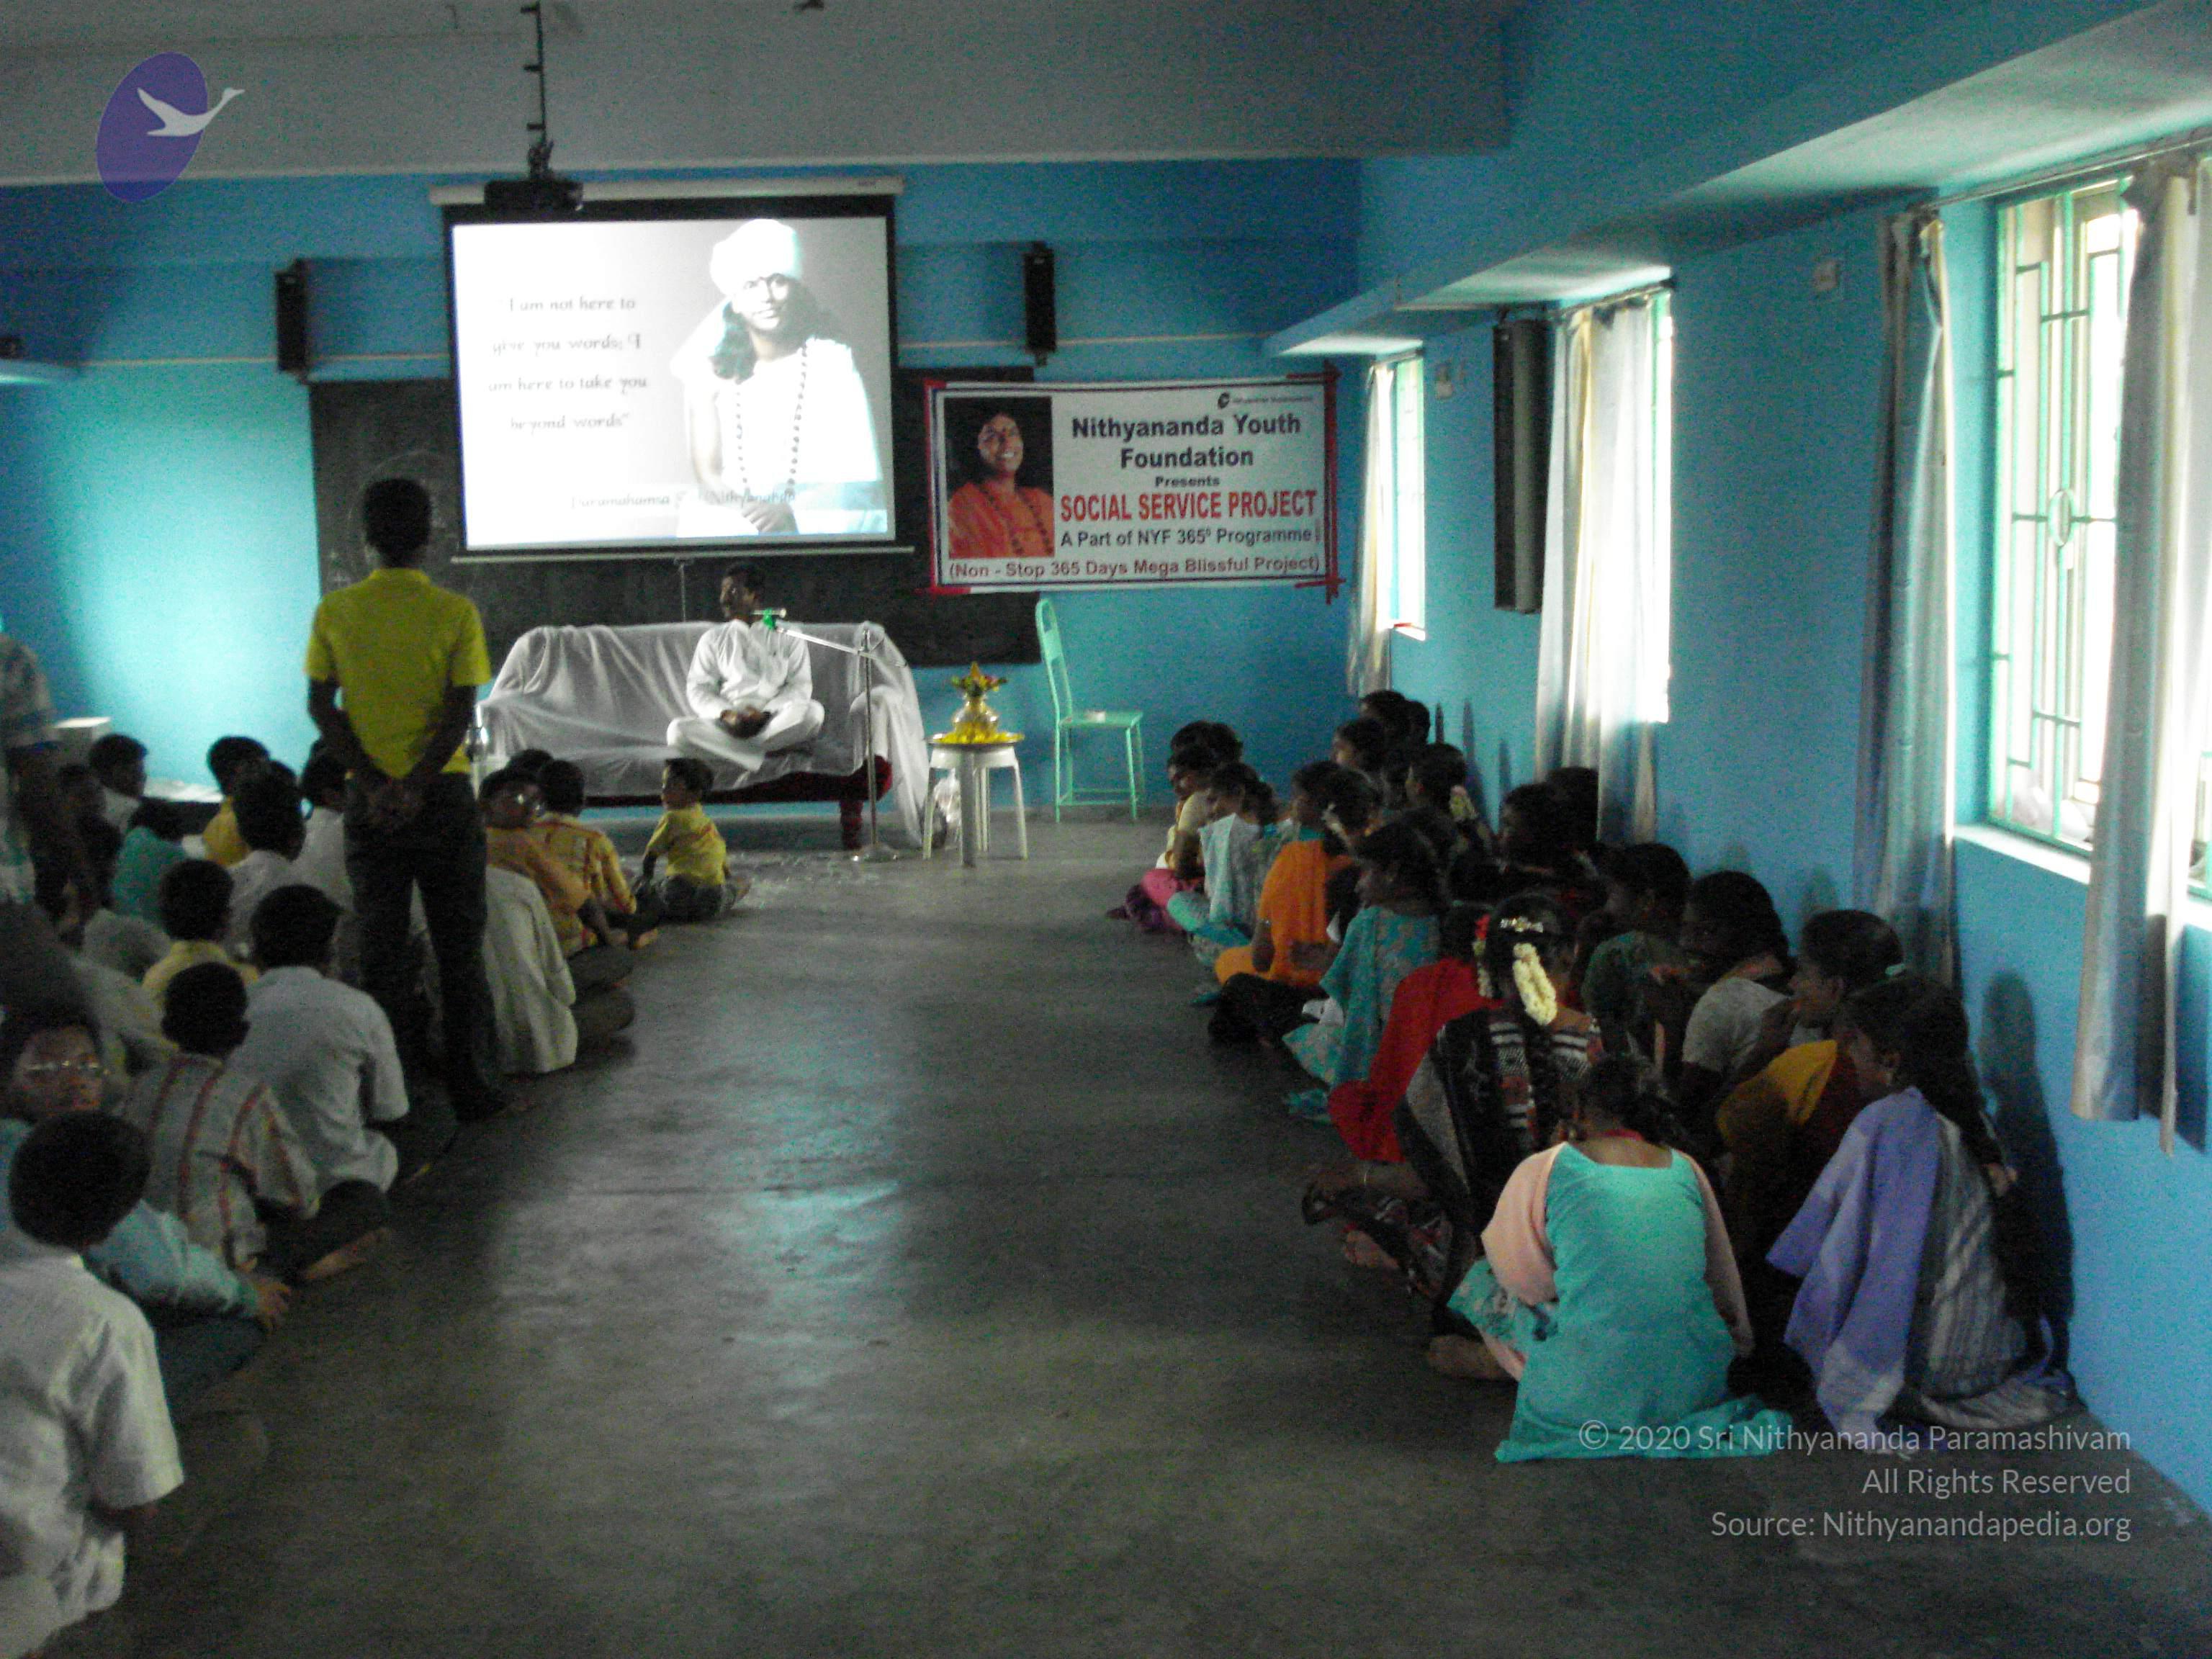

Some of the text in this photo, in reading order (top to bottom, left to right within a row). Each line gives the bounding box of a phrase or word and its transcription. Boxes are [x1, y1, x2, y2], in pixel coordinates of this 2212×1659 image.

[549, 298, 573, 310] not
[579, 295, 614, 310] here
[619, 297, 637, 310] to
[533, 341, 561, 356] you
[517, 377, 552, 390] here
[559, 377, 575, 390] to
[580, 374, 613, 389] take
[619, 377, 647, 395] you
[1071, 413, 1303, 444] Nithyananda Youth
[1120, 446, 1254, 469] Foundation
[1154, 475, 1220, 488] Presents
[1061, 490, 1318, 522] SOCIAL SERVICE PROJECT
[1061, 531, 1073, 547] A
[1078, 530, 1112, 547] Part
[1118, 529, 1133, 545] of
[1138, 529, 1172, 546] NYF
[1217, 527, 1313, 547] Programme
[950, 562, 990, 579] (Non
[1007, 561, 1046, 578] Stop
[1051, 560, 1081, 575] 365
[1086, 559, 1128, 578] Days
[1133, 558, 1181, 576] Mega
[1184, 557, 1249, 574] Blissful
[1254, 555, 1321, 573] Project)
